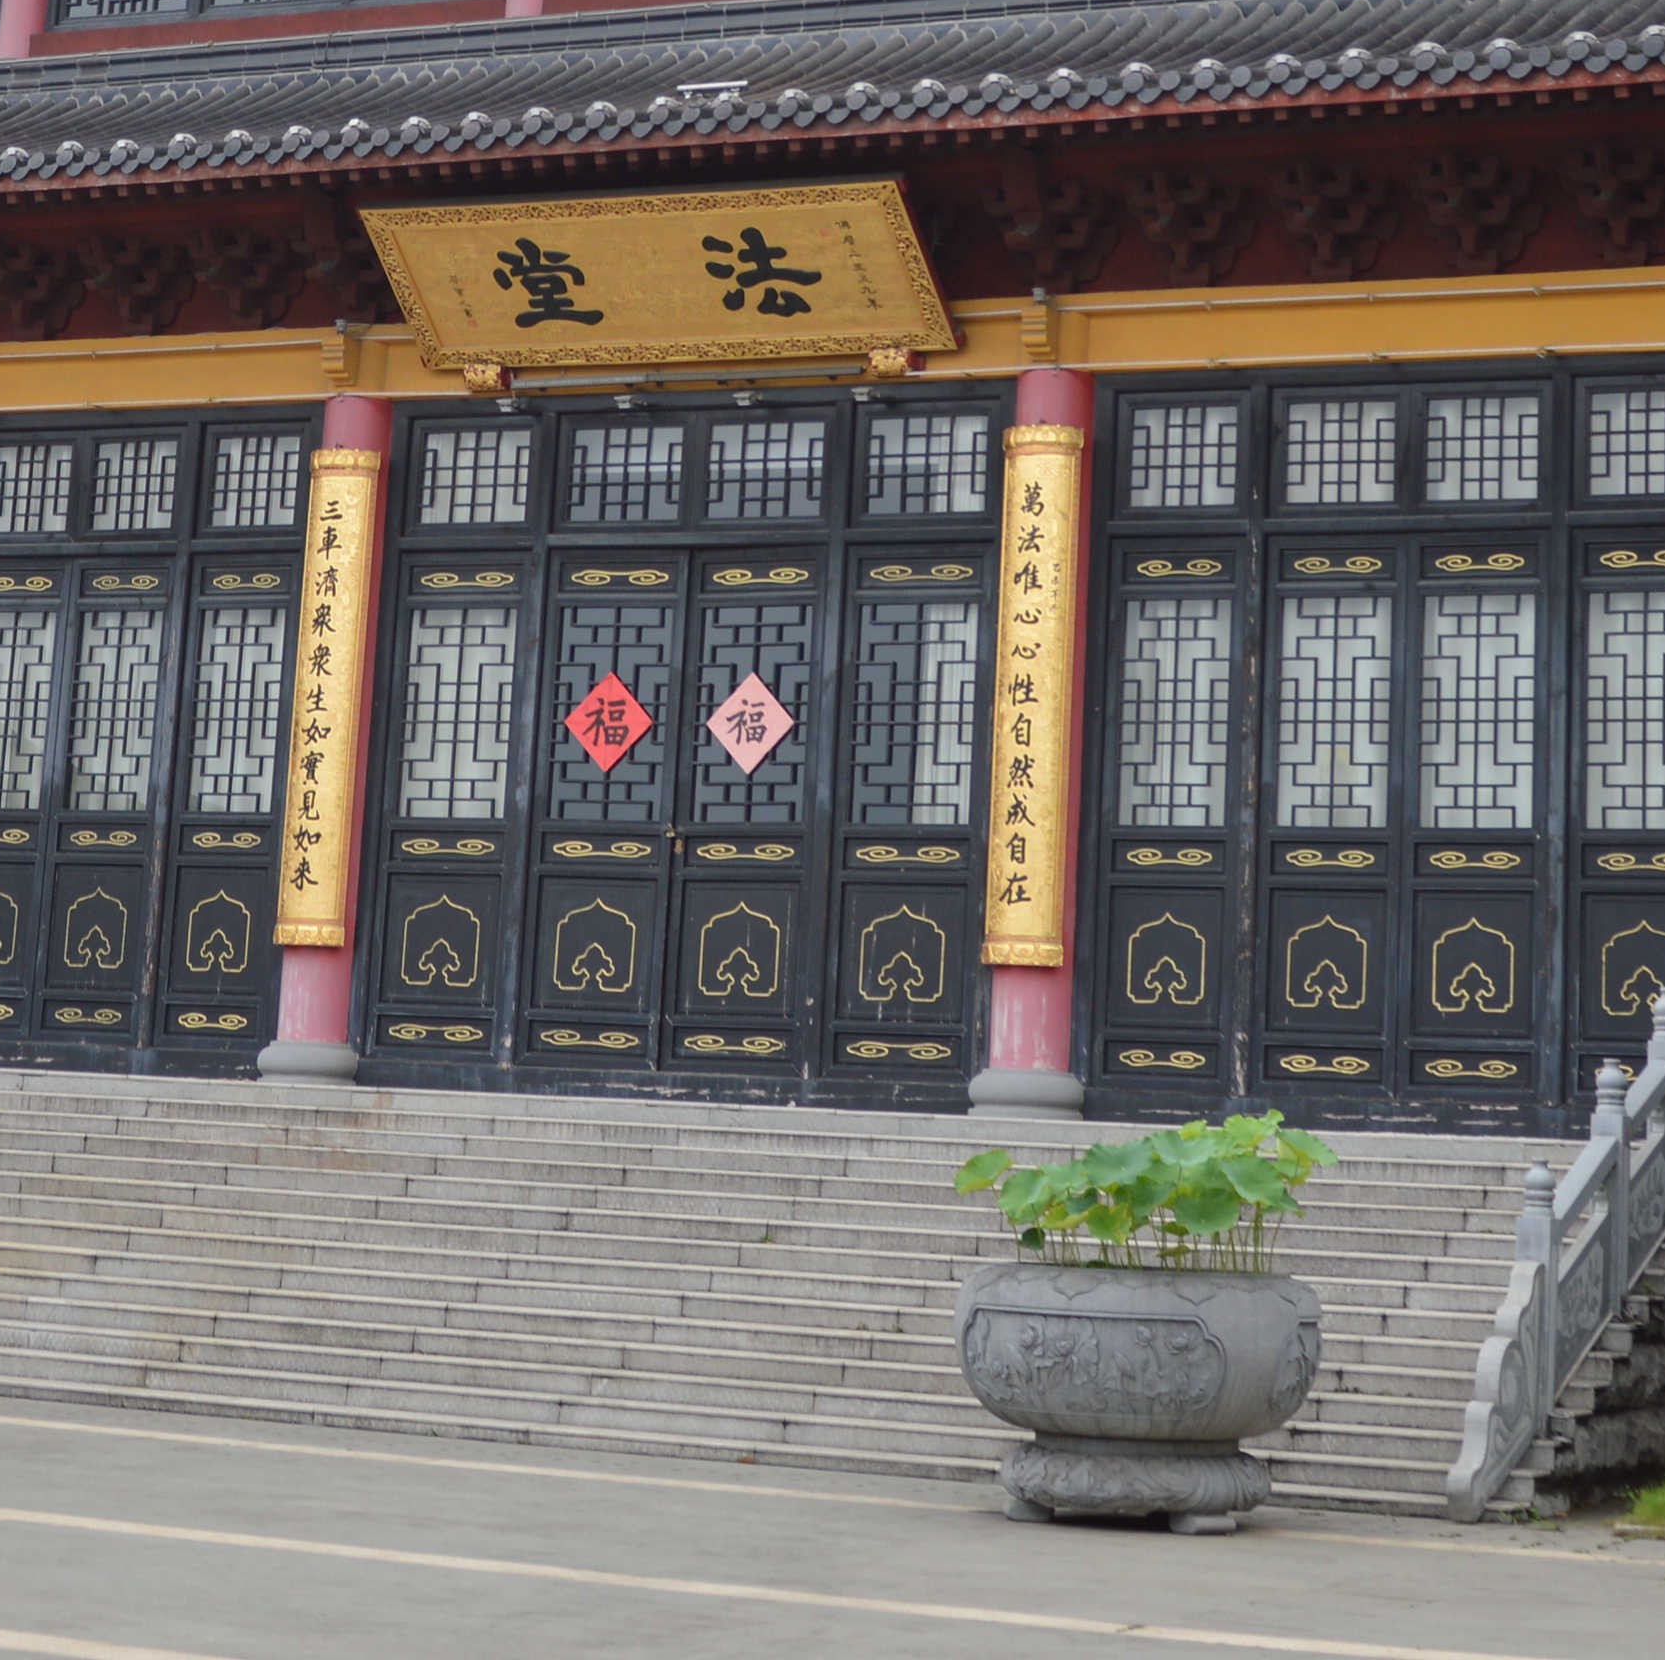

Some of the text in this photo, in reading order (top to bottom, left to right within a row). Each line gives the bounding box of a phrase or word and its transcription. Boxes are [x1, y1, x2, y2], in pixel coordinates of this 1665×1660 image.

[492, 226, 823, 329] 法堂
[582, 697, 631, 747] 福
[726, 699, 768, 745] 福
